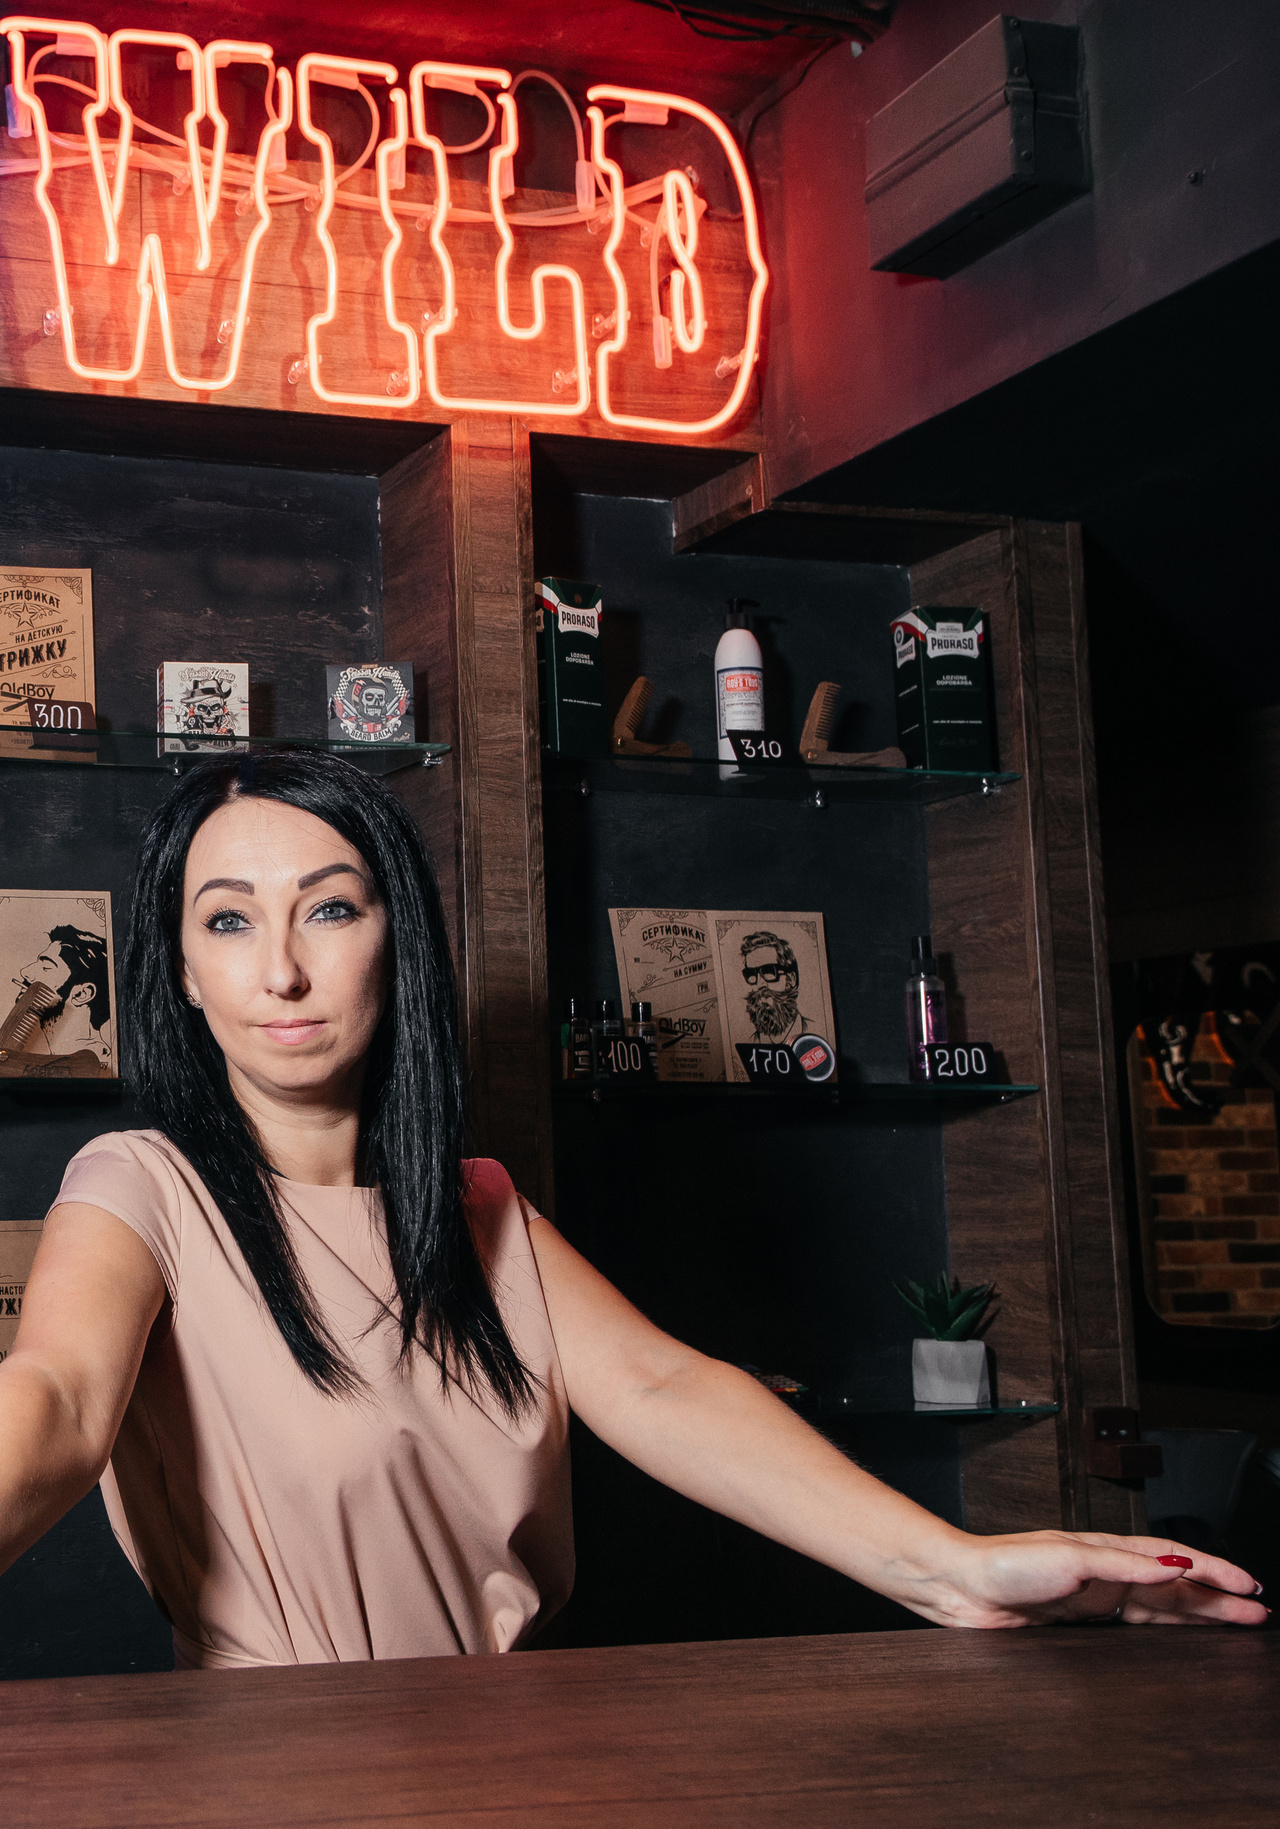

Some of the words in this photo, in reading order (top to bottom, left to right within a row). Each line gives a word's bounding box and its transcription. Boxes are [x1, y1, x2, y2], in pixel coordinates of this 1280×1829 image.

[561, 611, 596, 630] PRORASO
[15, 634, 26, 644] НА
[27, 624, 64, 642] ДЕТСКУЮ
[931, 637, 974, 650] PRORASO
[570, 652, 591, 660] LOZIONE
[0, 682, 56, 700] OldBoy
[34, 703, 82, 734] 300
[350, 729, 372, 741] BEARD
[373, 728, 392, 740] BALM
[740, 739, 782, 758] 310
[642, 925, 706, 943] СЕРТИФИКАТ
[673, 969, 683, 978] НА
[683, 961, 707, 975] СУММУ
[658, 1018, 706, 1036] OldBoy
[607, 1041, 642, 1072] 100
[749, 1048, 790, 1074] 170
[935, 1047, 987, 1076] 200
